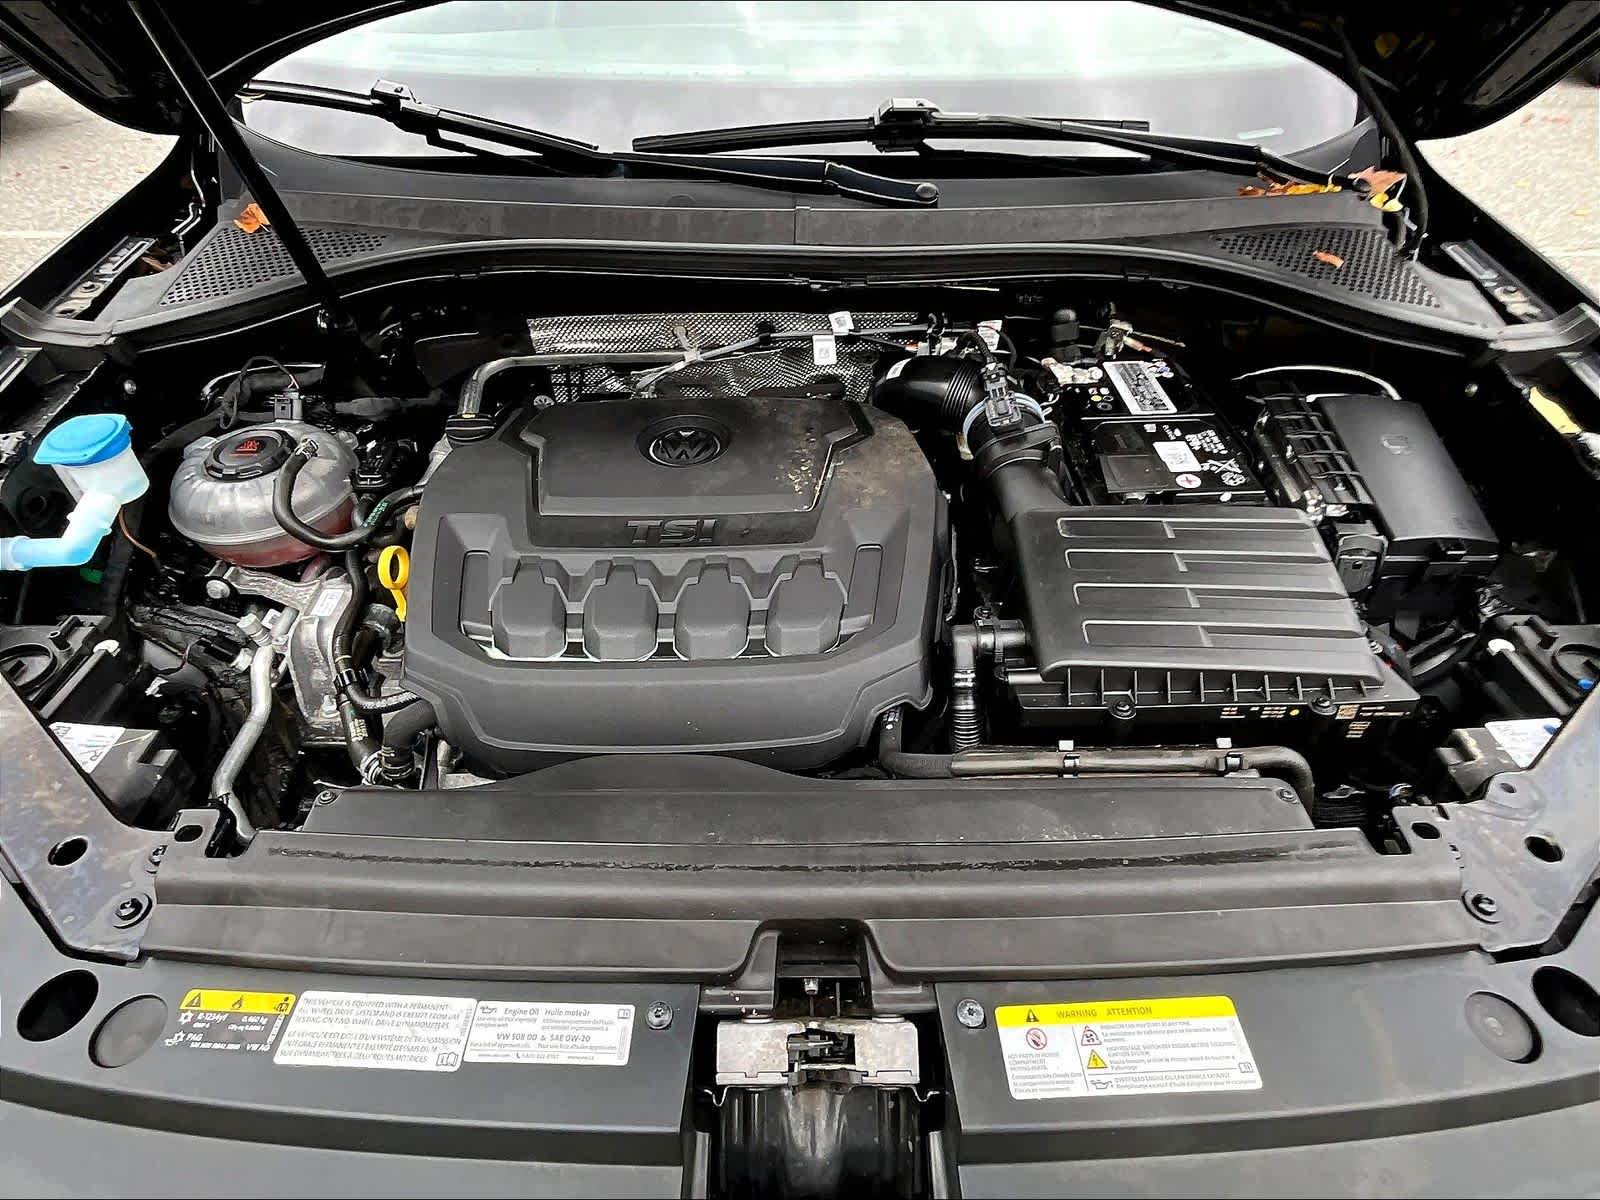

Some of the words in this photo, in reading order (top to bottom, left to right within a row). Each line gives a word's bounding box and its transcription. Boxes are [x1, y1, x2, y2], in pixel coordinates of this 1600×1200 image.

[625, 519, 717, 544] TSI
[352, 1000, 384, 1008] EQUIPPED
[504, 1007, 528, 1016] Engine
[528, 1007, 540, 1015] Oil
[1056, 1009, 1098, 1018] WARNING
[1106, 1006, 1152, 1016] ATTENTION
[186, 1033, 203, 1041] PAG
[526, 1033, 538, 1041] 00
[550, 1034, 564, 1042] SAE
[565, 1034, 591, 1042] 0W-20
